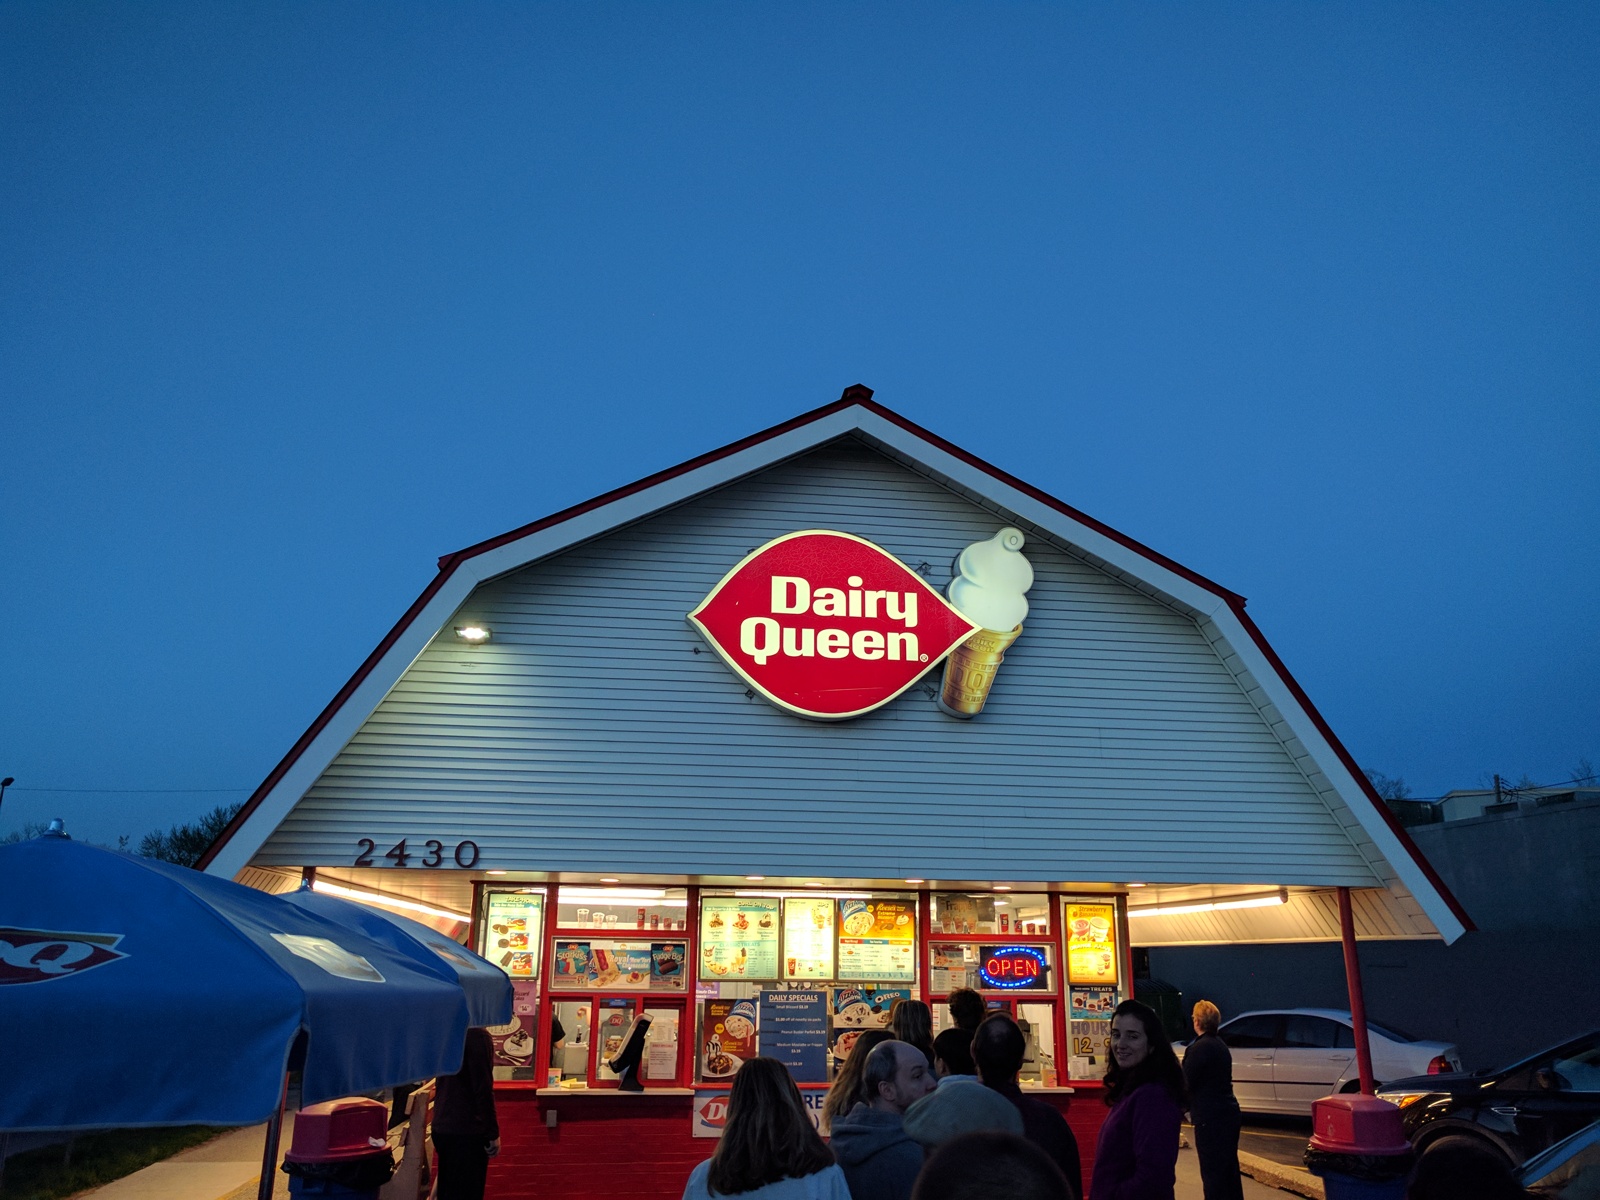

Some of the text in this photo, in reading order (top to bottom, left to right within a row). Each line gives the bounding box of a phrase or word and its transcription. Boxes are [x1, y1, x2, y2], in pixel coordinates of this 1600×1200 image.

[771, 575, 918, 628] Dairy
[740, 616, 919, 665] Queen
[950, 662, 987, 693] DQ
[354, 838, 479, 868] 2430
[0, 940, 94, 974] Q
[987, 958, 1037, 977] OPEN
[875, 992, 900, 1003] OREO
[1071, 1021, 1111, 1035] HOUR
